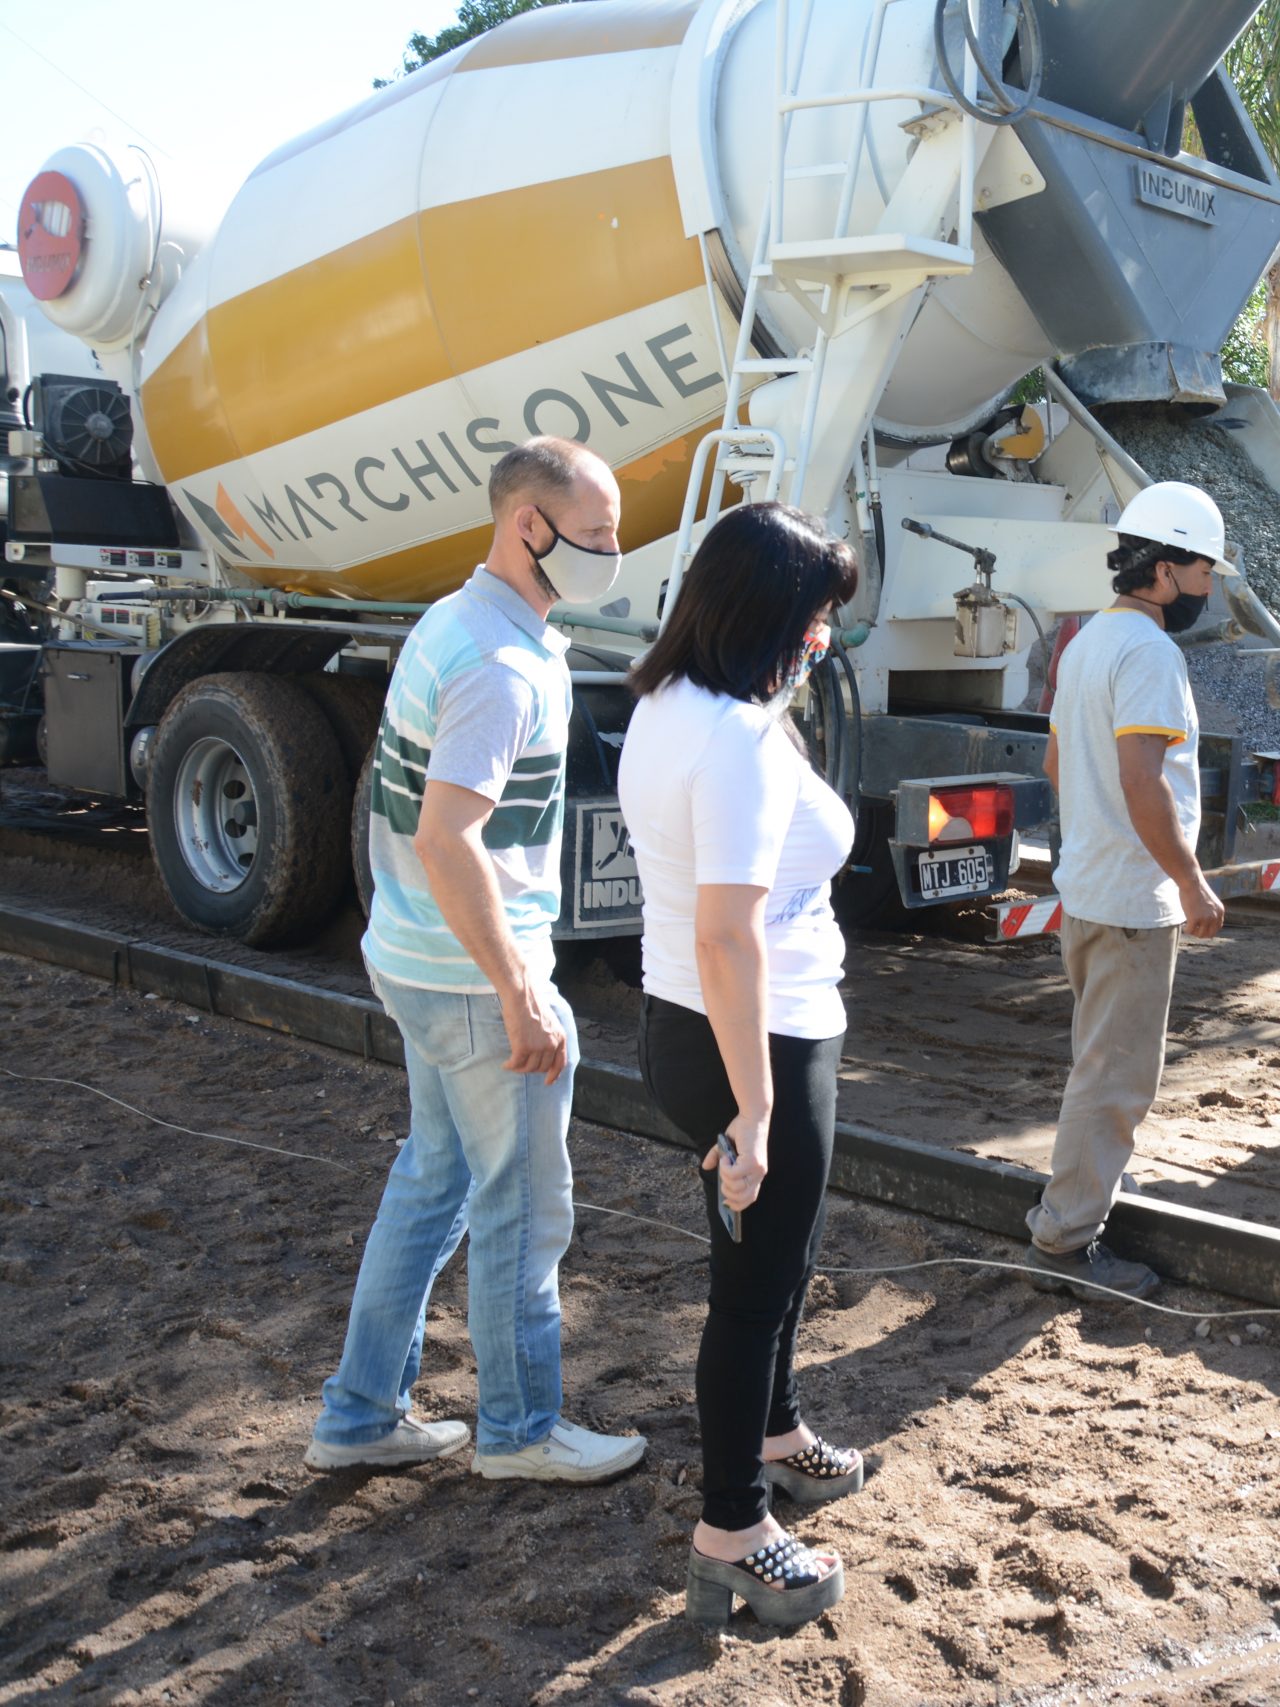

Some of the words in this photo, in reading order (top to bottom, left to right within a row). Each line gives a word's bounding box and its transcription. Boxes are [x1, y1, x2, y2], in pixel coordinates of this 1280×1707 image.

[1142, 171, 1216, 218] INDUMIX
[244, 323, 723, 541] MARCHISONE
[922, 861, 951, 890] MTJ
[957, 857, 986, 885] 605
